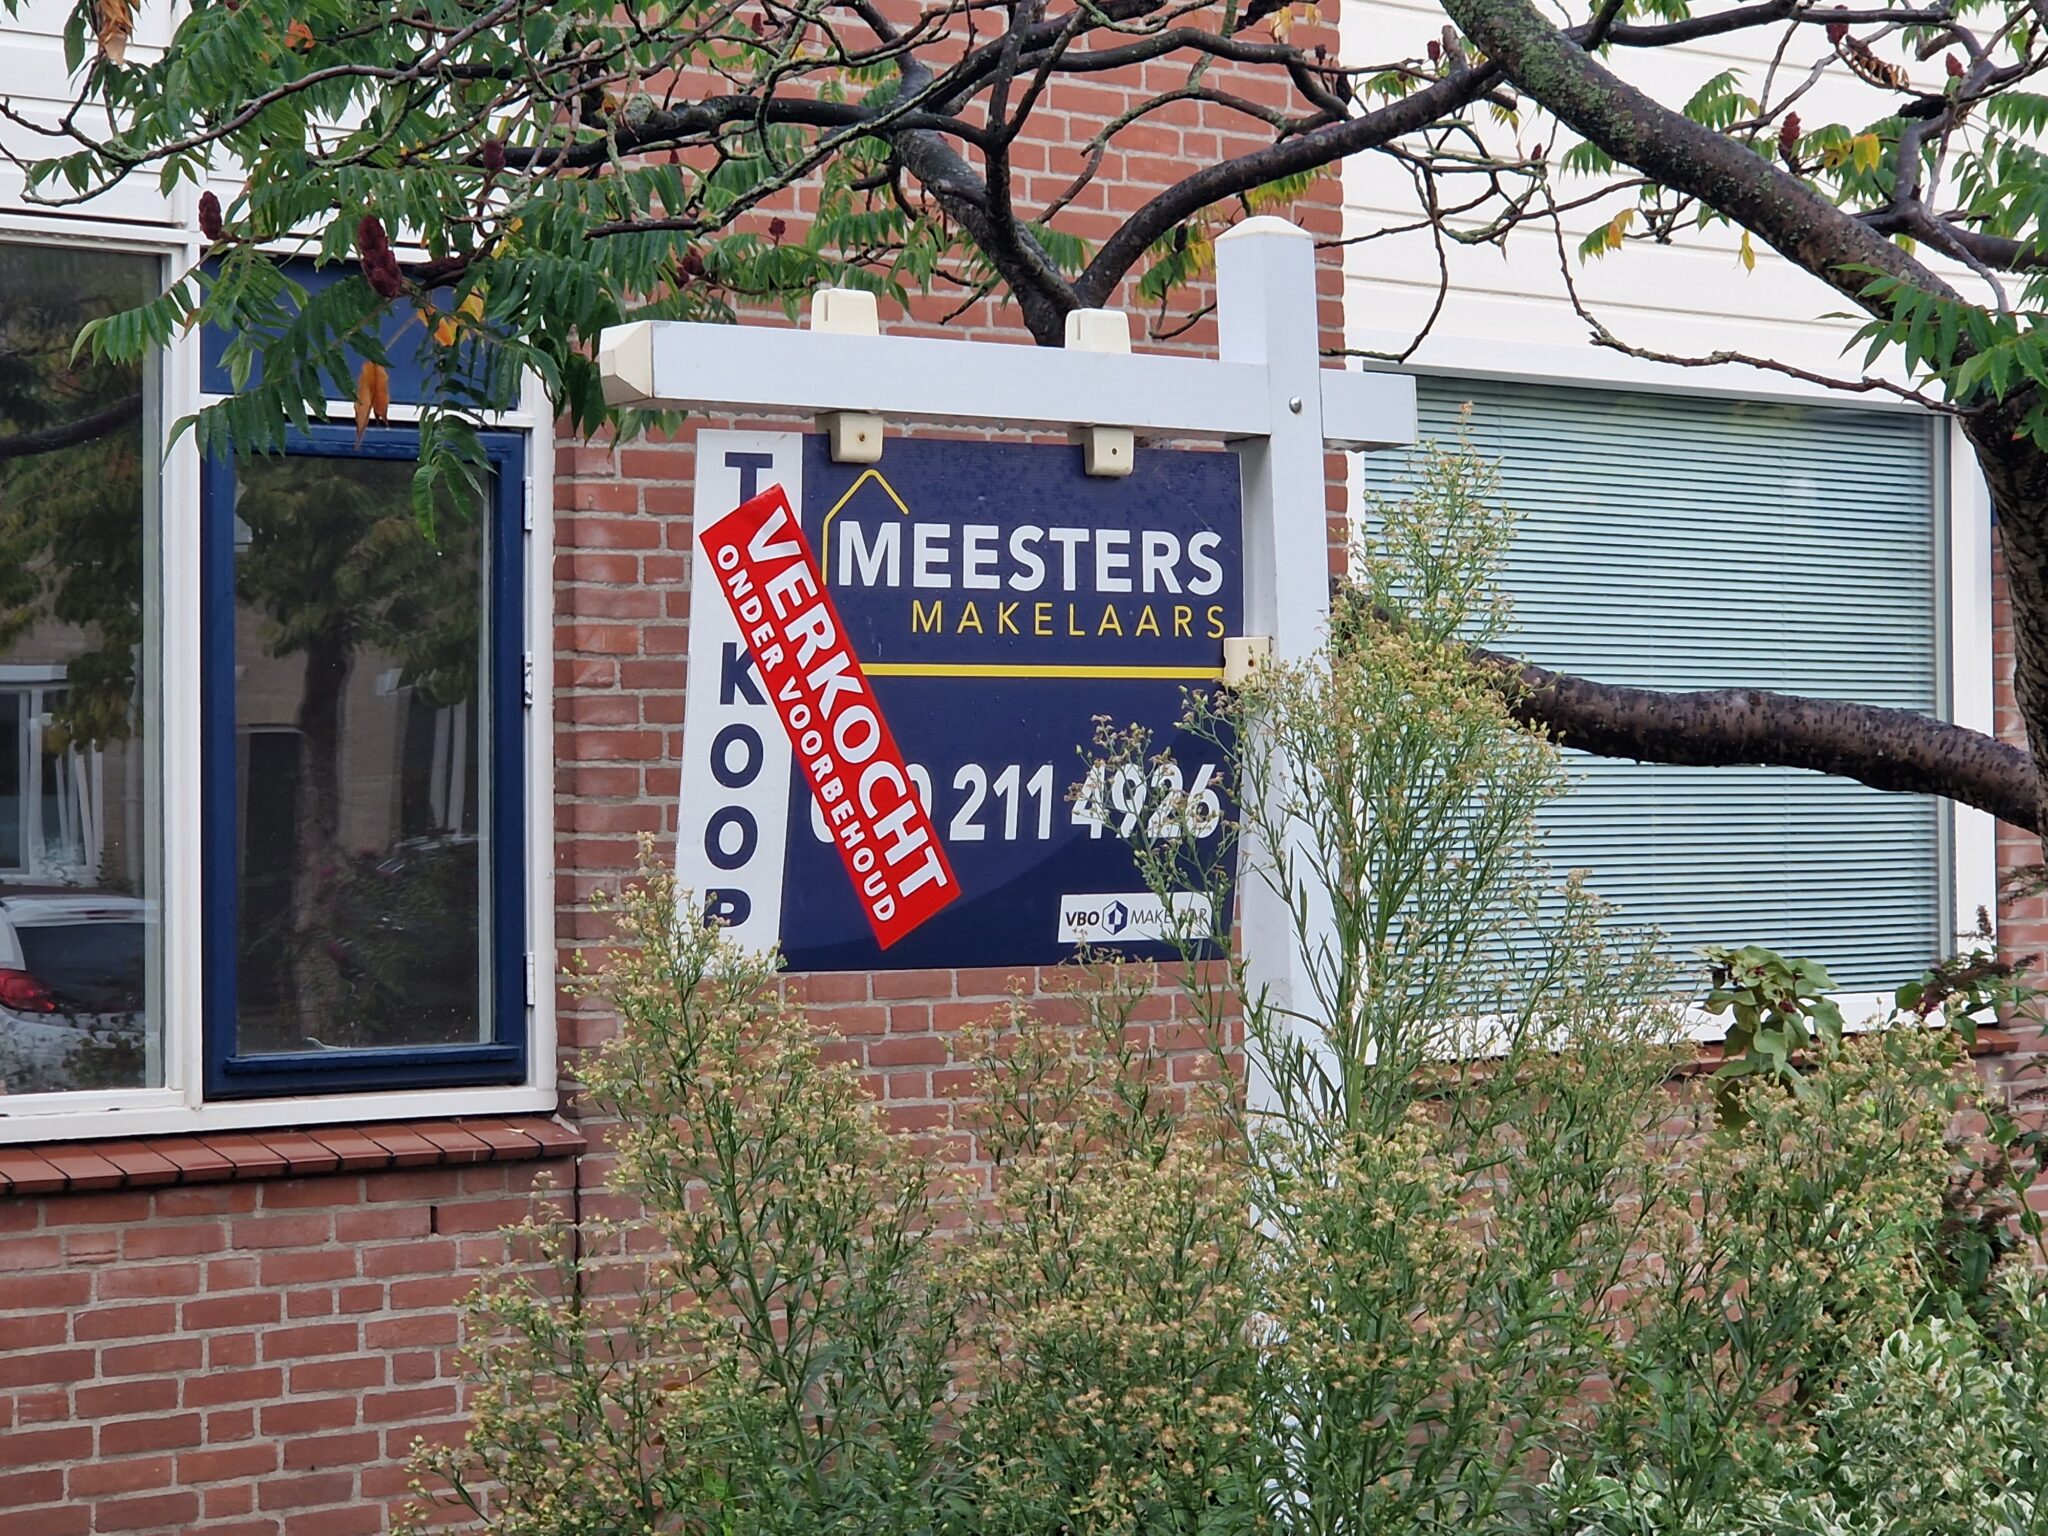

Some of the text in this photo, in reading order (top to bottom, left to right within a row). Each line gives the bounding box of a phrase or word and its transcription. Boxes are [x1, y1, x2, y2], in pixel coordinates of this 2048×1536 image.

[838, 520, 1223, 596] MEESTERS
[912, 600, 1226, 639] MAKELAARS
[718, 544, 784, 671] ONDER
[778, 676, 896, 921] VOORBEHOUD
[747, 505, 948, 899] VERKOCHT
[703, 641, 768, 929] KOOP
[949, 763, 1054, 841] 211
[1071, 763, 1220, 839] 4926
[1065, 911, 1100, 926] VBO
